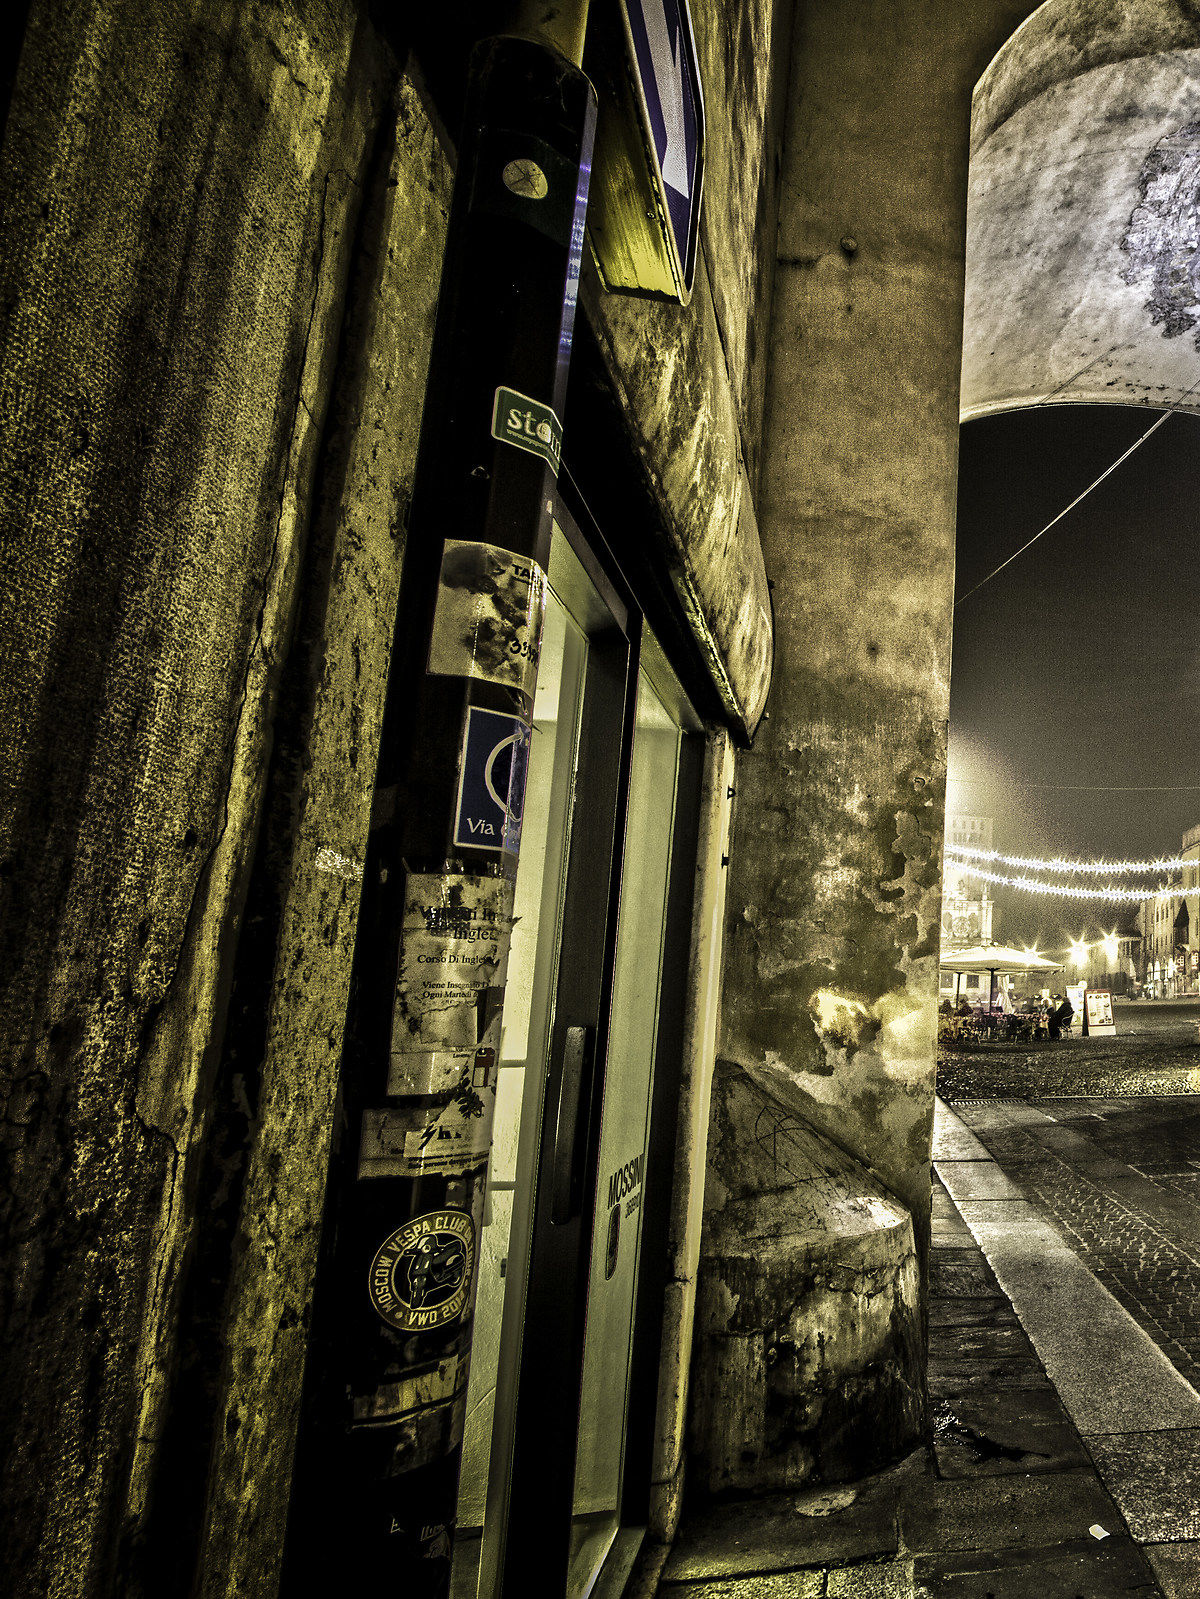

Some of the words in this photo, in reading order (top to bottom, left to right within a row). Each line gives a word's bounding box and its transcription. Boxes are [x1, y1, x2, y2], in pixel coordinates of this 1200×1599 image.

[467, 817, 495, 836] Via
[417, 954, 446, 964] Corso
[448, 954, 459, 964] Di
[374, 1255, 398, 1313] MOSCOW
[387, 1220, 431, 1252] VESPA
[435, 1216, 467, 1233] CLUB
